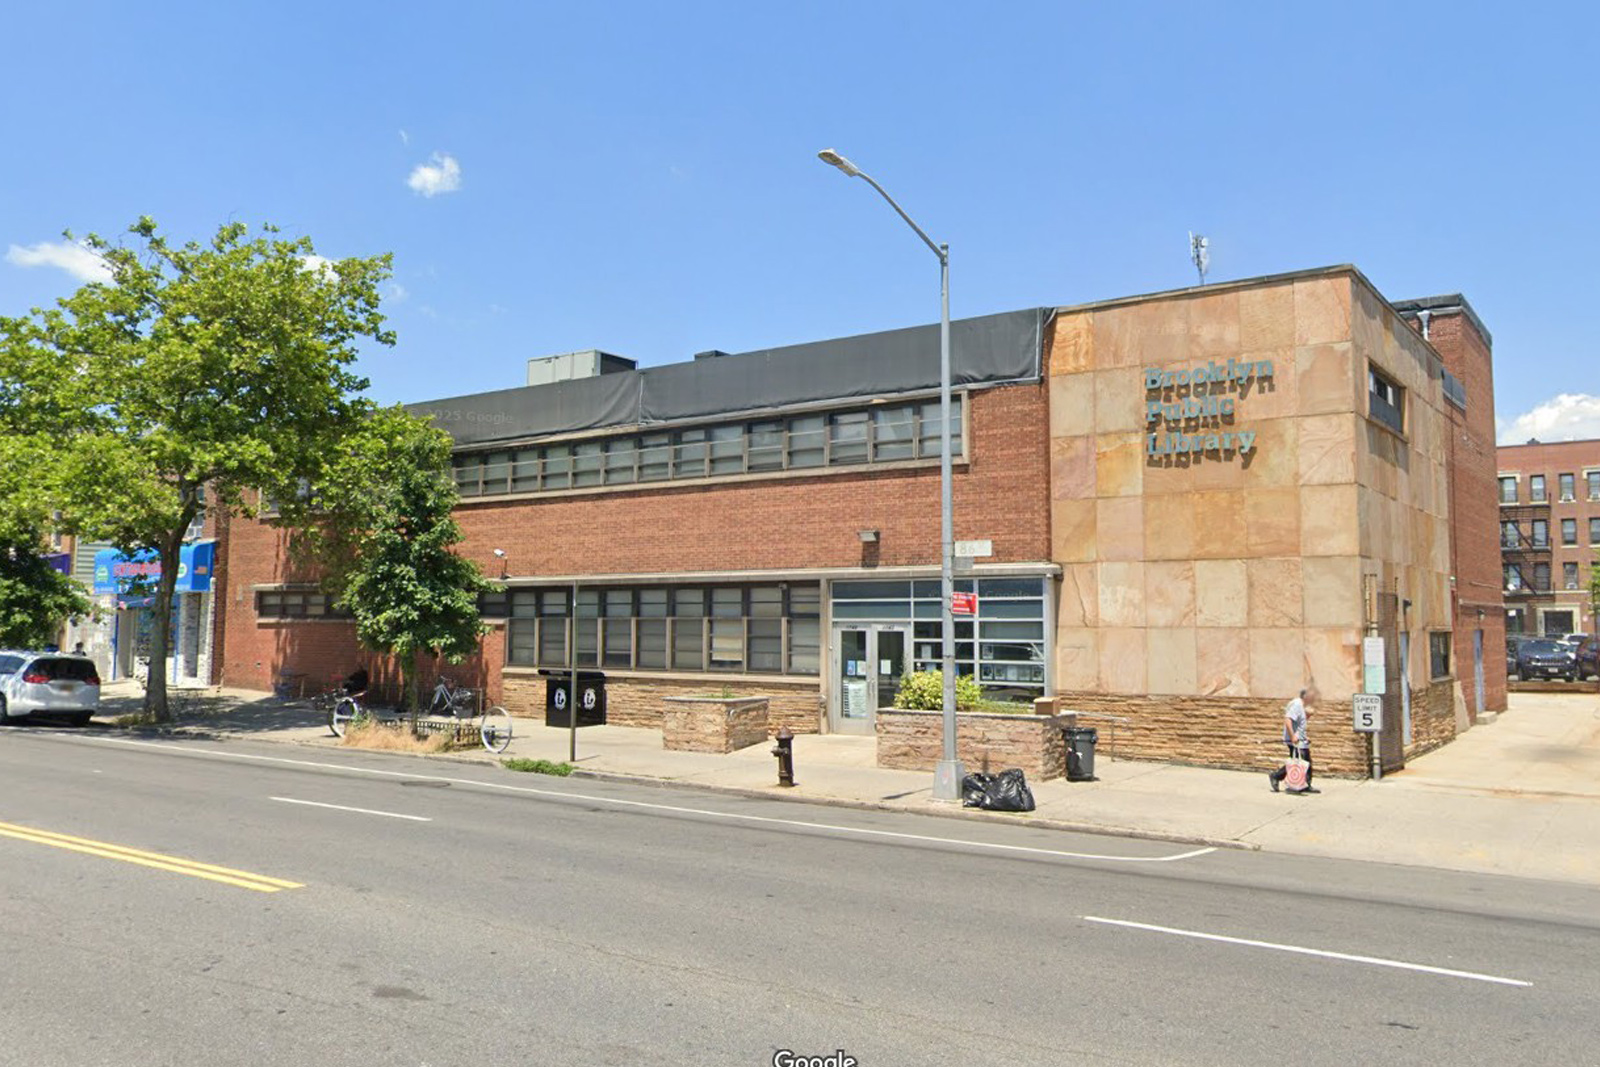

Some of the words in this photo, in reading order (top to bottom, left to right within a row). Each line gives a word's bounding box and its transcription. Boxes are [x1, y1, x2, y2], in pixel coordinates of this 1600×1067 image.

[1145, 358, 1273, 389] Brooklyn
[1146, 395, 1234, 421] Public
[1147, 430, 1256, 455] Library
[1362, 713, 1373, 727] 5
